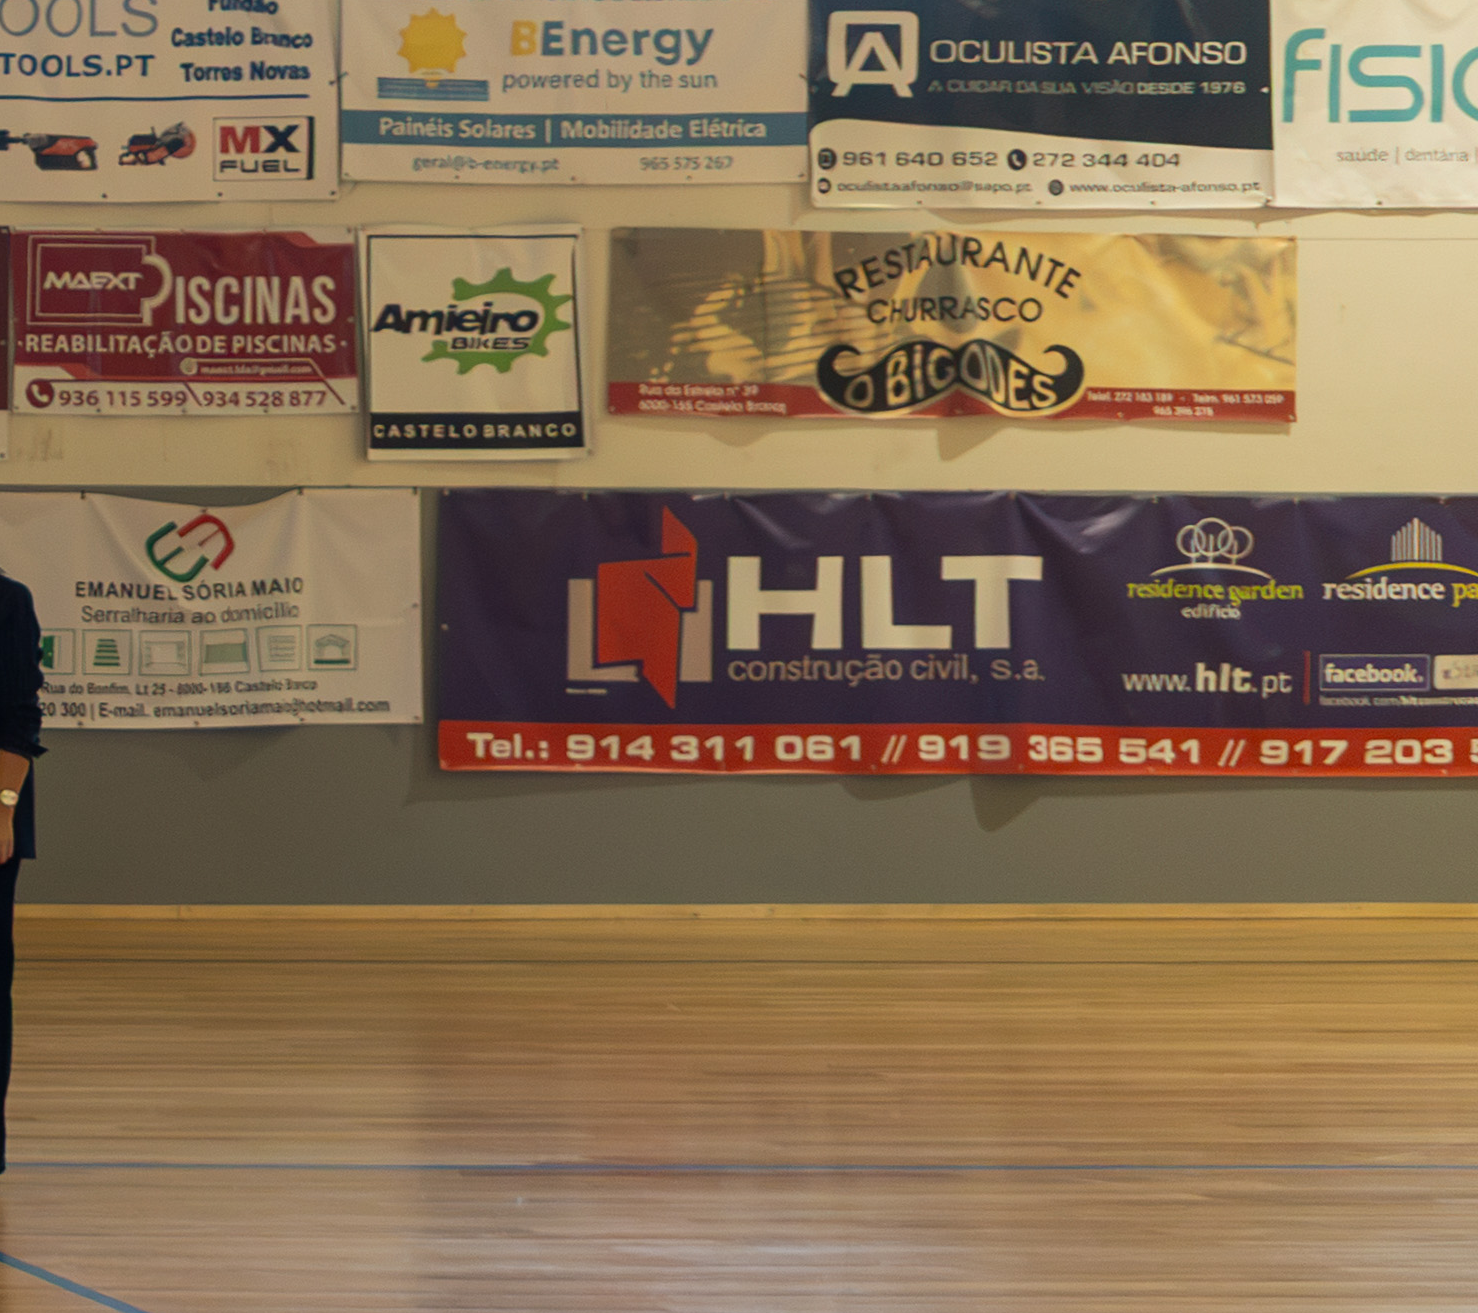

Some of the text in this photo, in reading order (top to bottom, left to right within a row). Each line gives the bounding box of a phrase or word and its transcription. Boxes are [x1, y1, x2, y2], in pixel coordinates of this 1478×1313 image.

[511, 20, 714, 66] BEnergy
[930, 39, 1247, 66] OCULISTA AFONSO
[180, 62, 310, 82] Torres Novas
[502, 70, 717, 93] powered by the sun
[220, 125, 301, 153] MX
[378, 117, 766, 139] Painéis Solares Mobilidade Elétrica
[220, 160, 301, 173] FUEL
[843, 152, 887, 166] 961
[952, 152, 998, 166] 652
[1033, 152, 1074, 167] 272
[1083, 152, 1128, 167] 344
[834, 234, 1081, 298] RESTAURANTE
[370, 302, 539, 334] Amieiro
[867, 296, 1043, 323] CHURRASCO
[26, 332, 336, 358] REABILITAÇÃO DE PISCINAS
[451, 337, 530, 350] BIKES
[887, 342, 1057, 409] BIGODES
[373, 423, 576, 438] CASTELO BRANCO
[75, 577, 303, 601] EMANUEL SÓRIA MAIO
[1127, 578, 1225, 600] residence
[81, 605, 184, 625] Serralharia
[192, 608, 216, 624] ao
[727, 555, 1043, 650] HLT
[728, 652, 1046, 686] construção civil, s.a.
[1122, 662, 1292, 699] www.hlt.pt
[466, 732, 1453, 765] Tel.: 914 311 061 919 365 541 917 203
